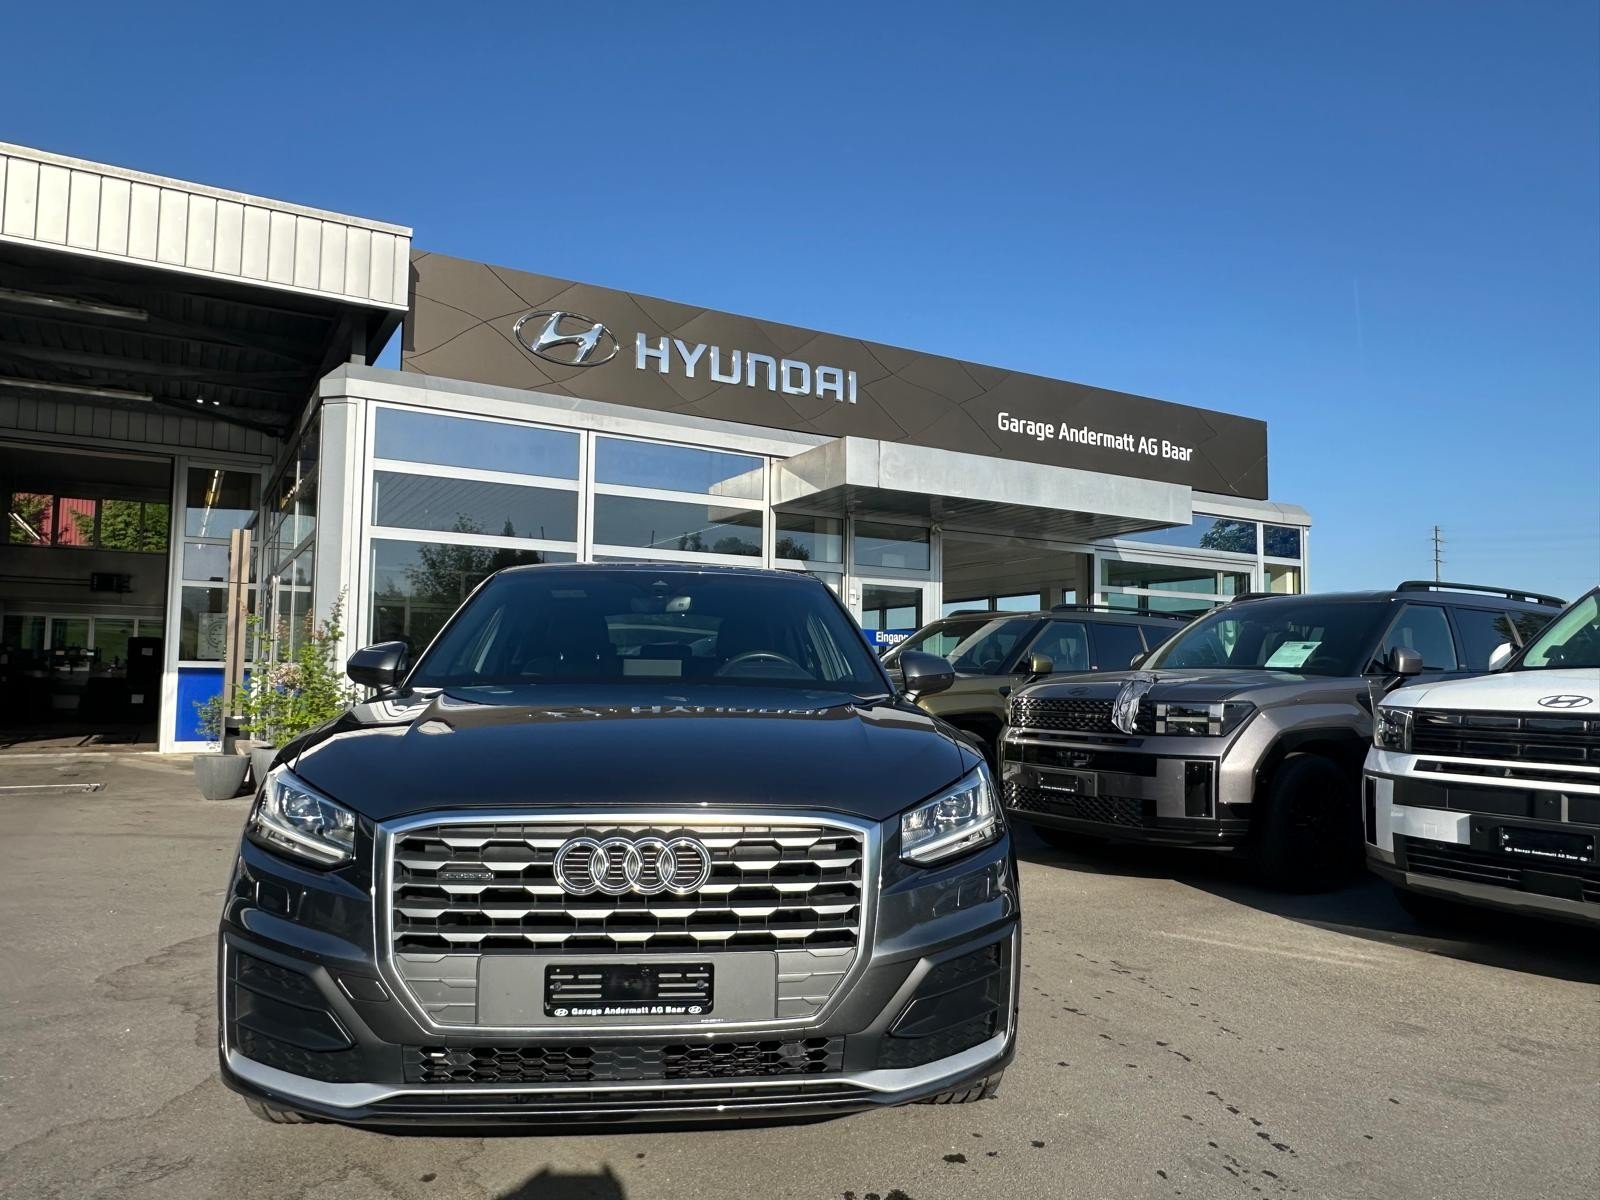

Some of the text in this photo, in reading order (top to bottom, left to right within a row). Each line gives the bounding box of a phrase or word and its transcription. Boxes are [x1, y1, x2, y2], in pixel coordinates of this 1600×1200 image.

[635, 332, 857, 404] HYUNDAI
[997, 412, 1193, 462] Garage Andermatt AG Baar
[604, 1006, 649, 1015] Andermatt
[650, 1006, 664, 1014] AG
